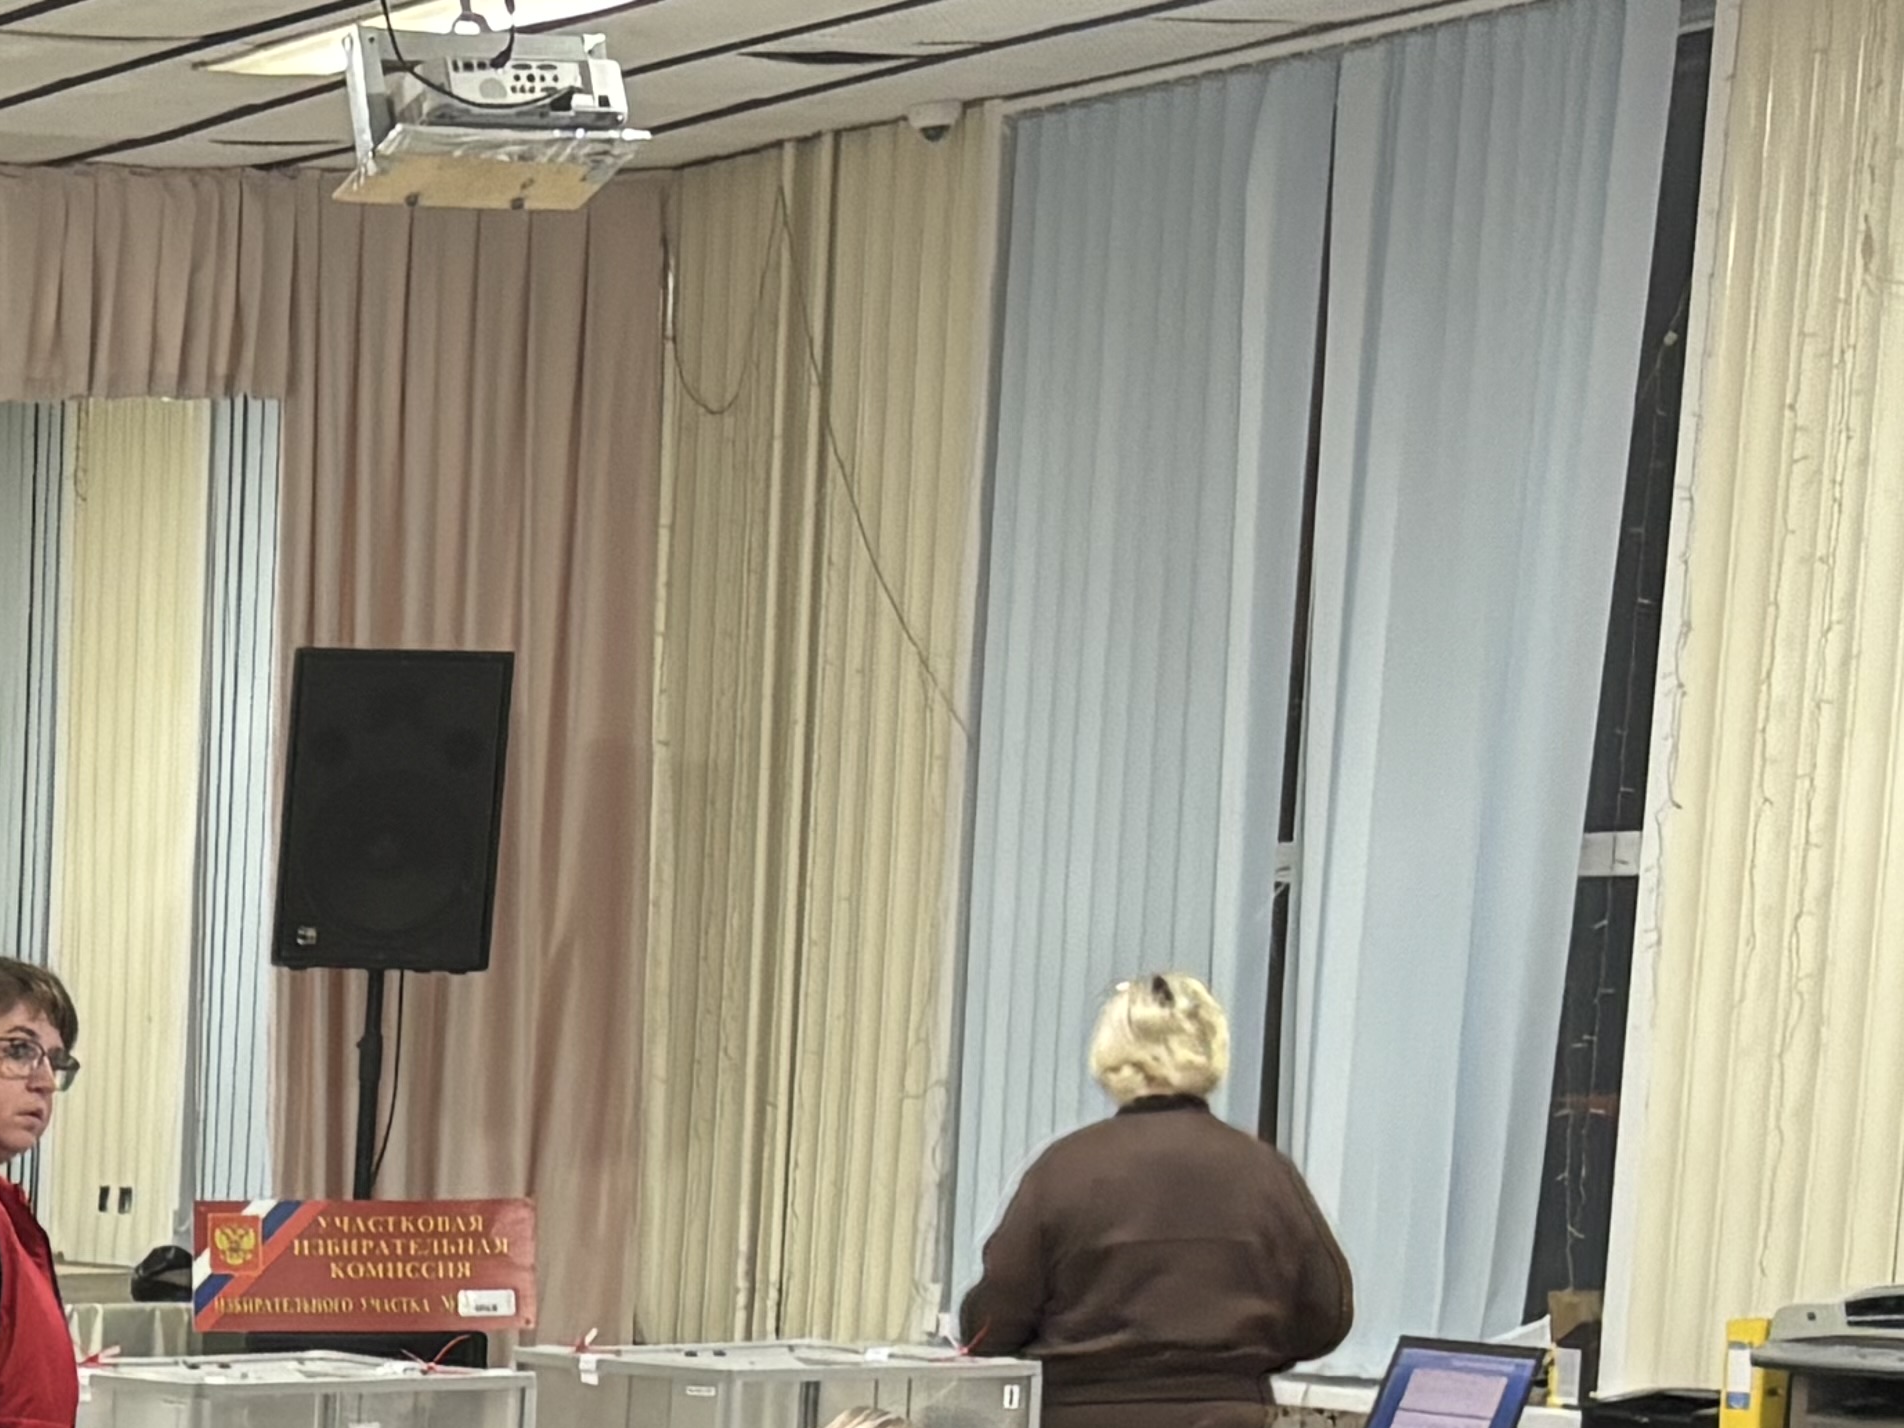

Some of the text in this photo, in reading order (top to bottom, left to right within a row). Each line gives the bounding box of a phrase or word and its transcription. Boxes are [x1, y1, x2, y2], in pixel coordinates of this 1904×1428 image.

[318, 1215, 484, 1234] УЧАСТКОВАЯ
[293, 1238, 510, 1258] ИЗБИРАТЕЛЬНАЯ
[330, 1261, 472, 1280] КОМИССИЯ
